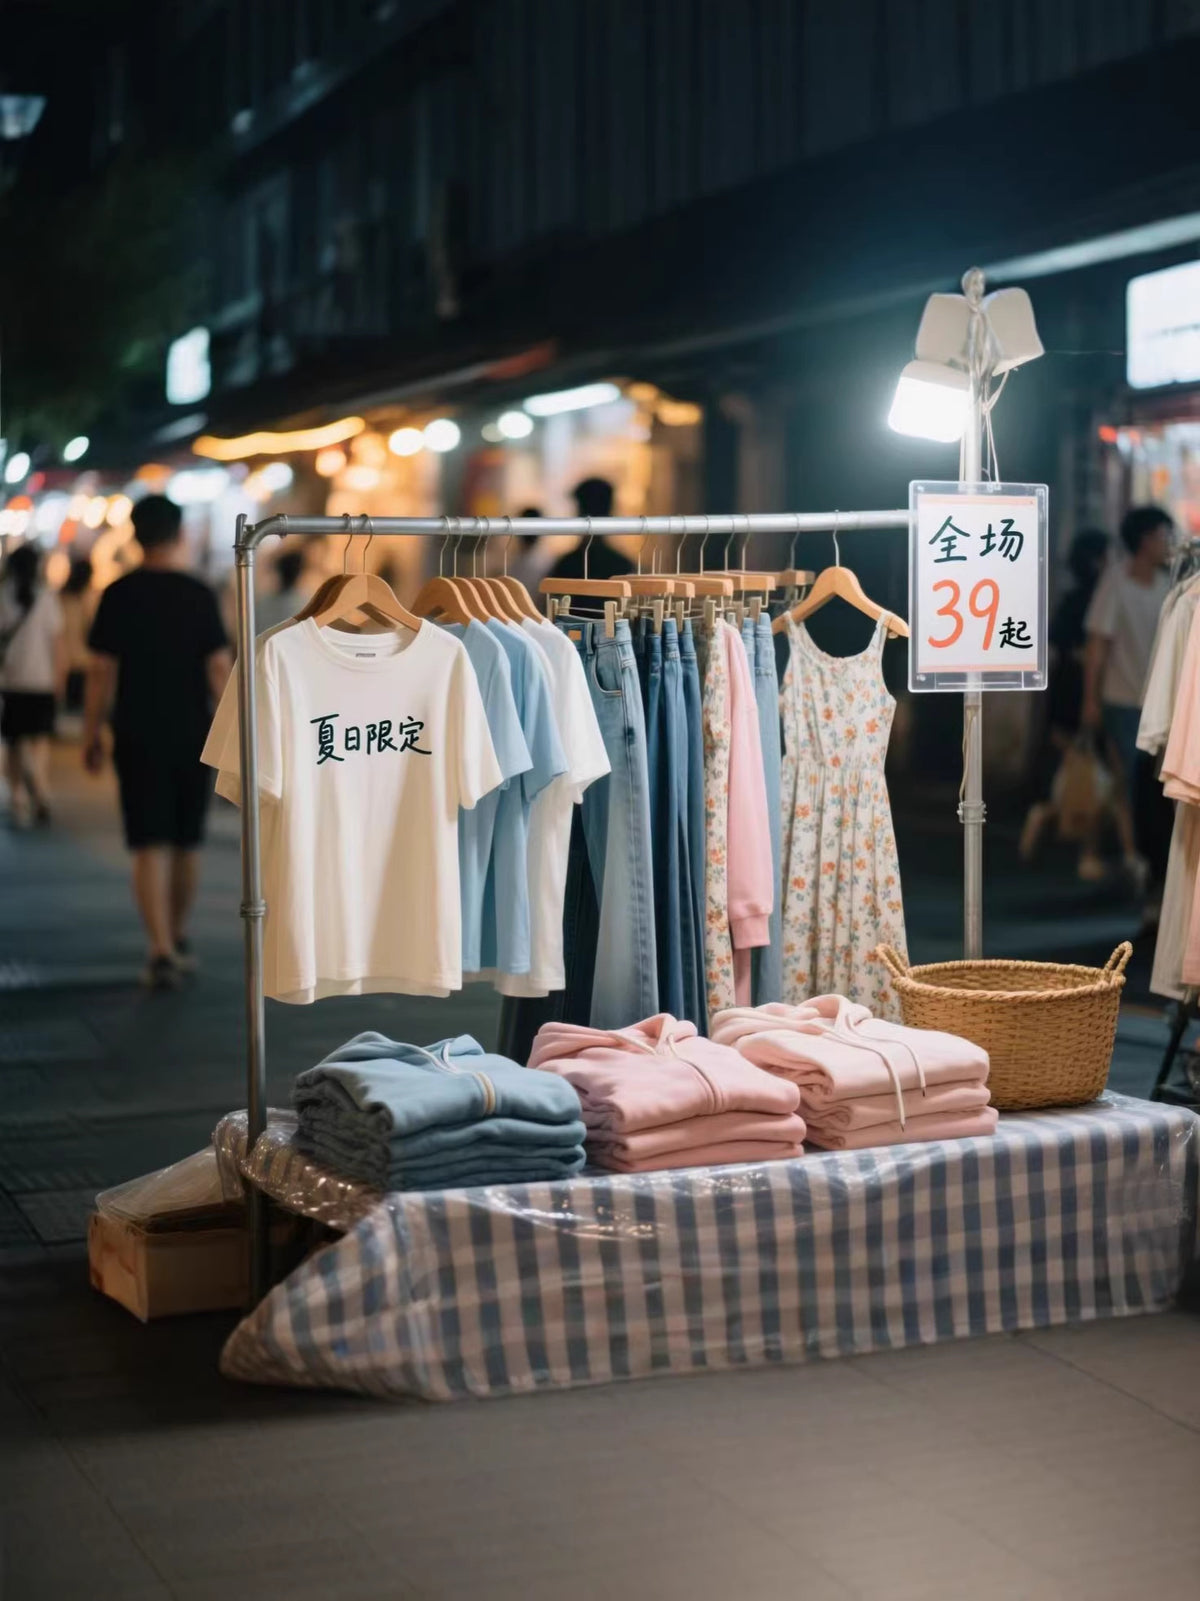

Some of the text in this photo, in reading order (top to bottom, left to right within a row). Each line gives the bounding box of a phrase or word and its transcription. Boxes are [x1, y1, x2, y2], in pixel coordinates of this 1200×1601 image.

[928, 515, 1024, 563] 全场
[310, 713, 432, 765] 夏日限定
